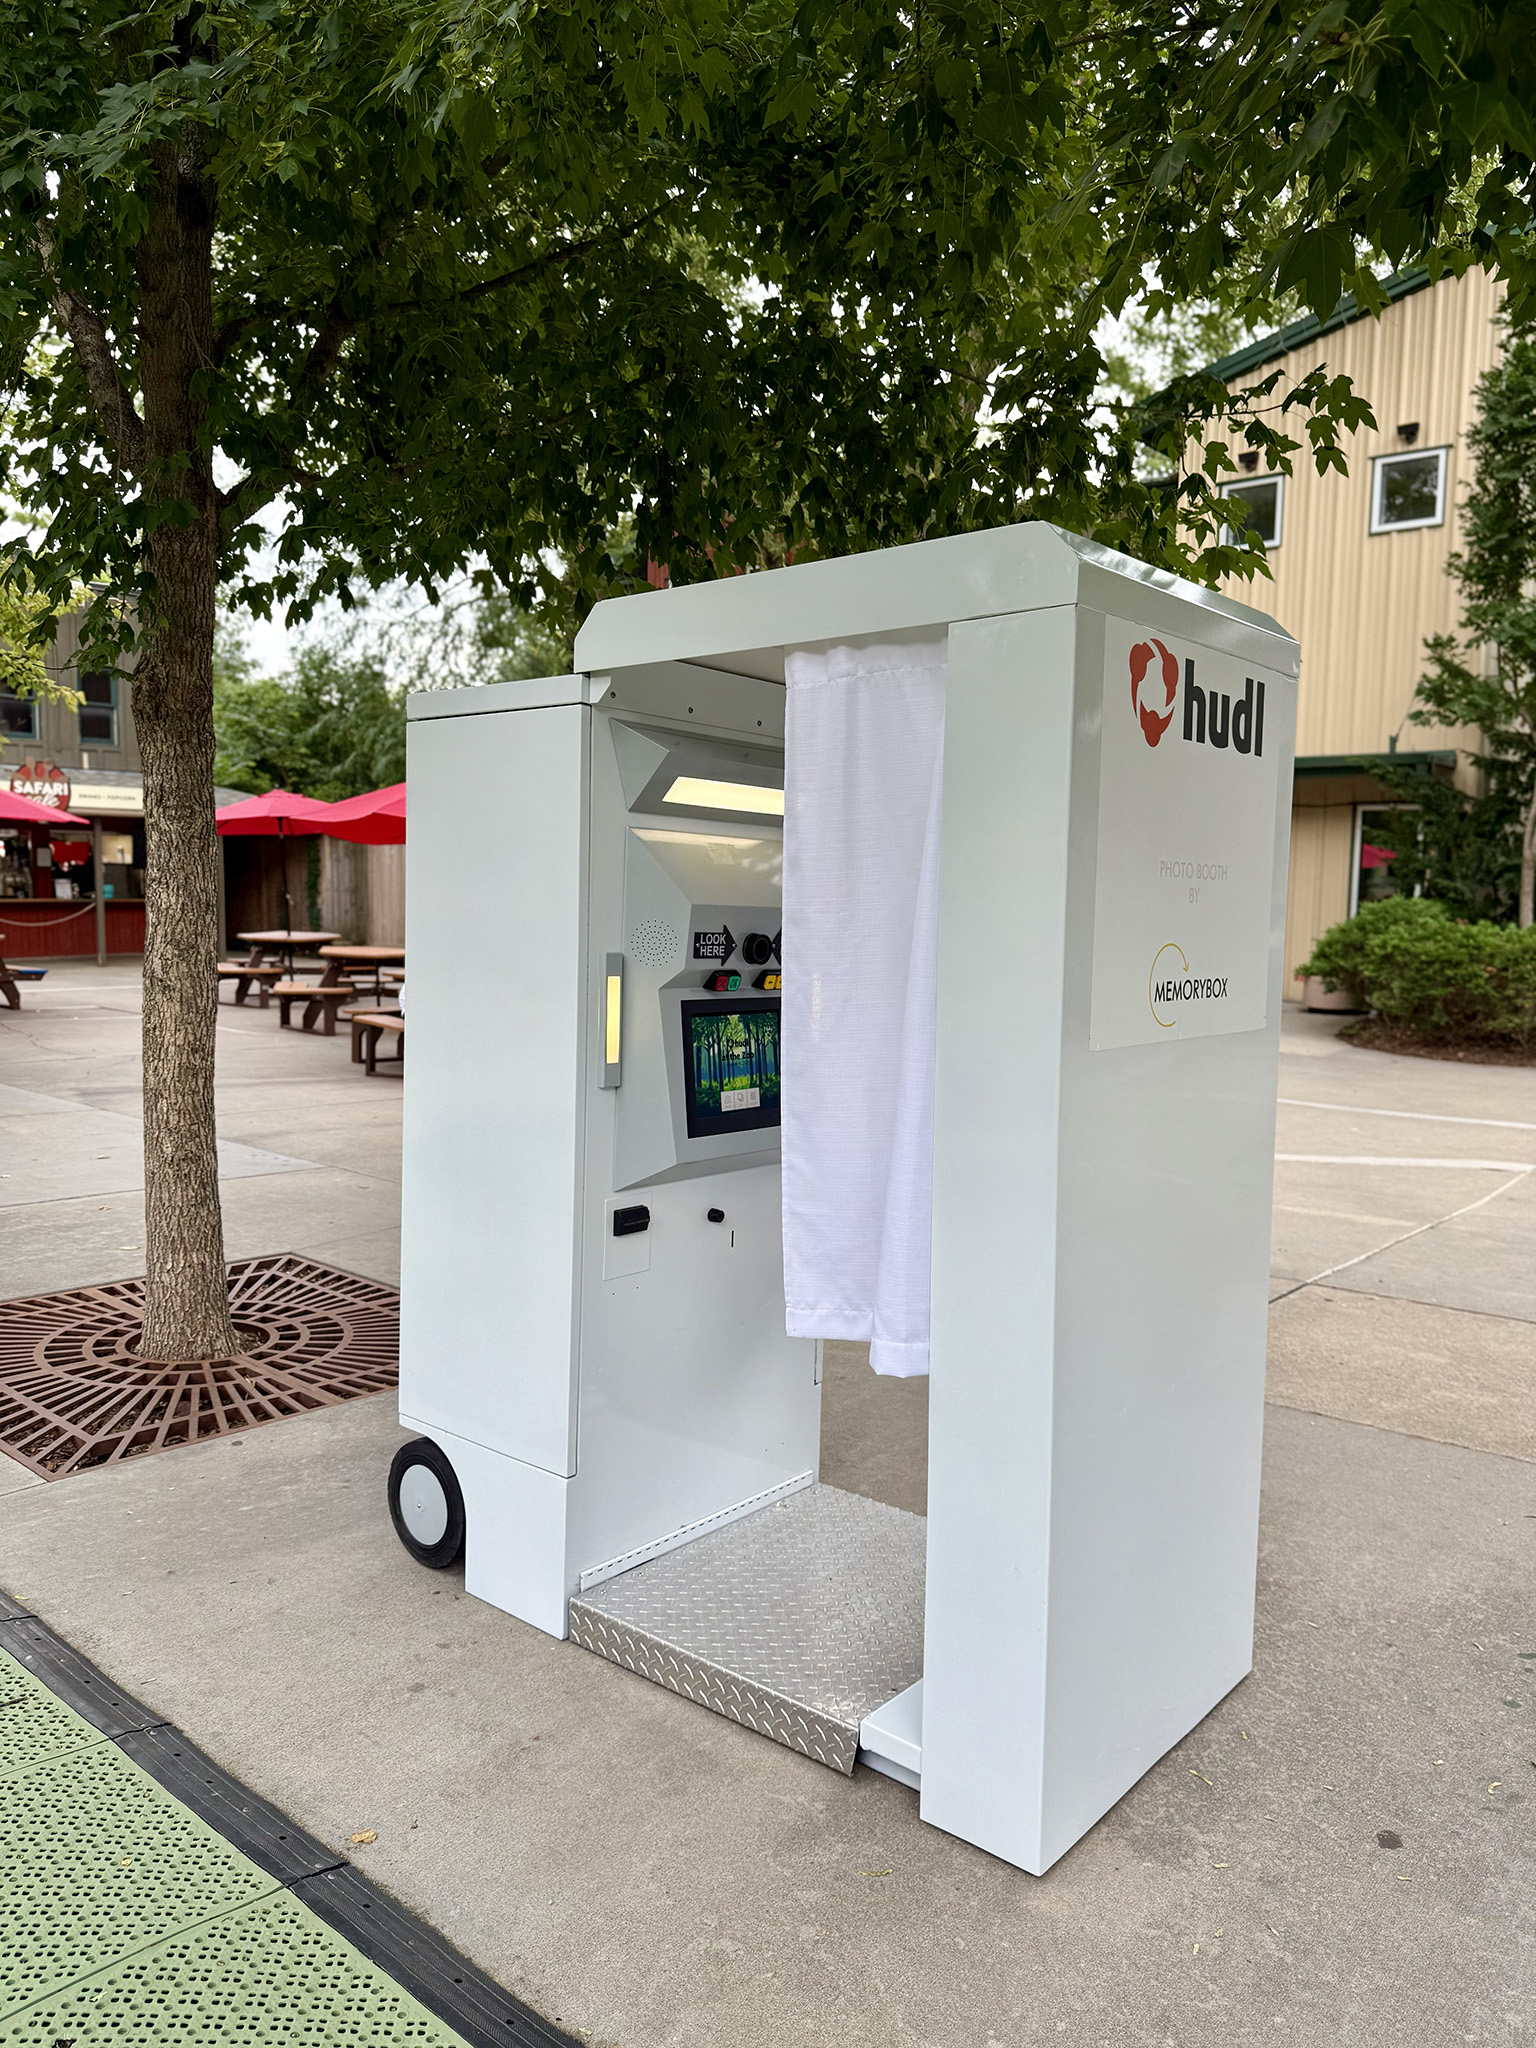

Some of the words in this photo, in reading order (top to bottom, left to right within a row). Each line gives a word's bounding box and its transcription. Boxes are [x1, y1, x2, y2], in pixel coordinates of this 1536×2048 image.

[1183, 658, 1265, 757] hudl
[13, 781, 69, 796] SAFARI
[1160, 861, 1194, 879] PHOTO
[1196, 864, 1228, 881] BOOTH
[1189, 887, 1200, 904] BY
[700, 934, 726, 945] LOOK
[700, 945, 726, 956] HERE
[1154, 978, 1228, 1003] MEMORYBOX
[730, 1051, 741, 1060] the
[742, 1051, 755, 1060] Zoo
